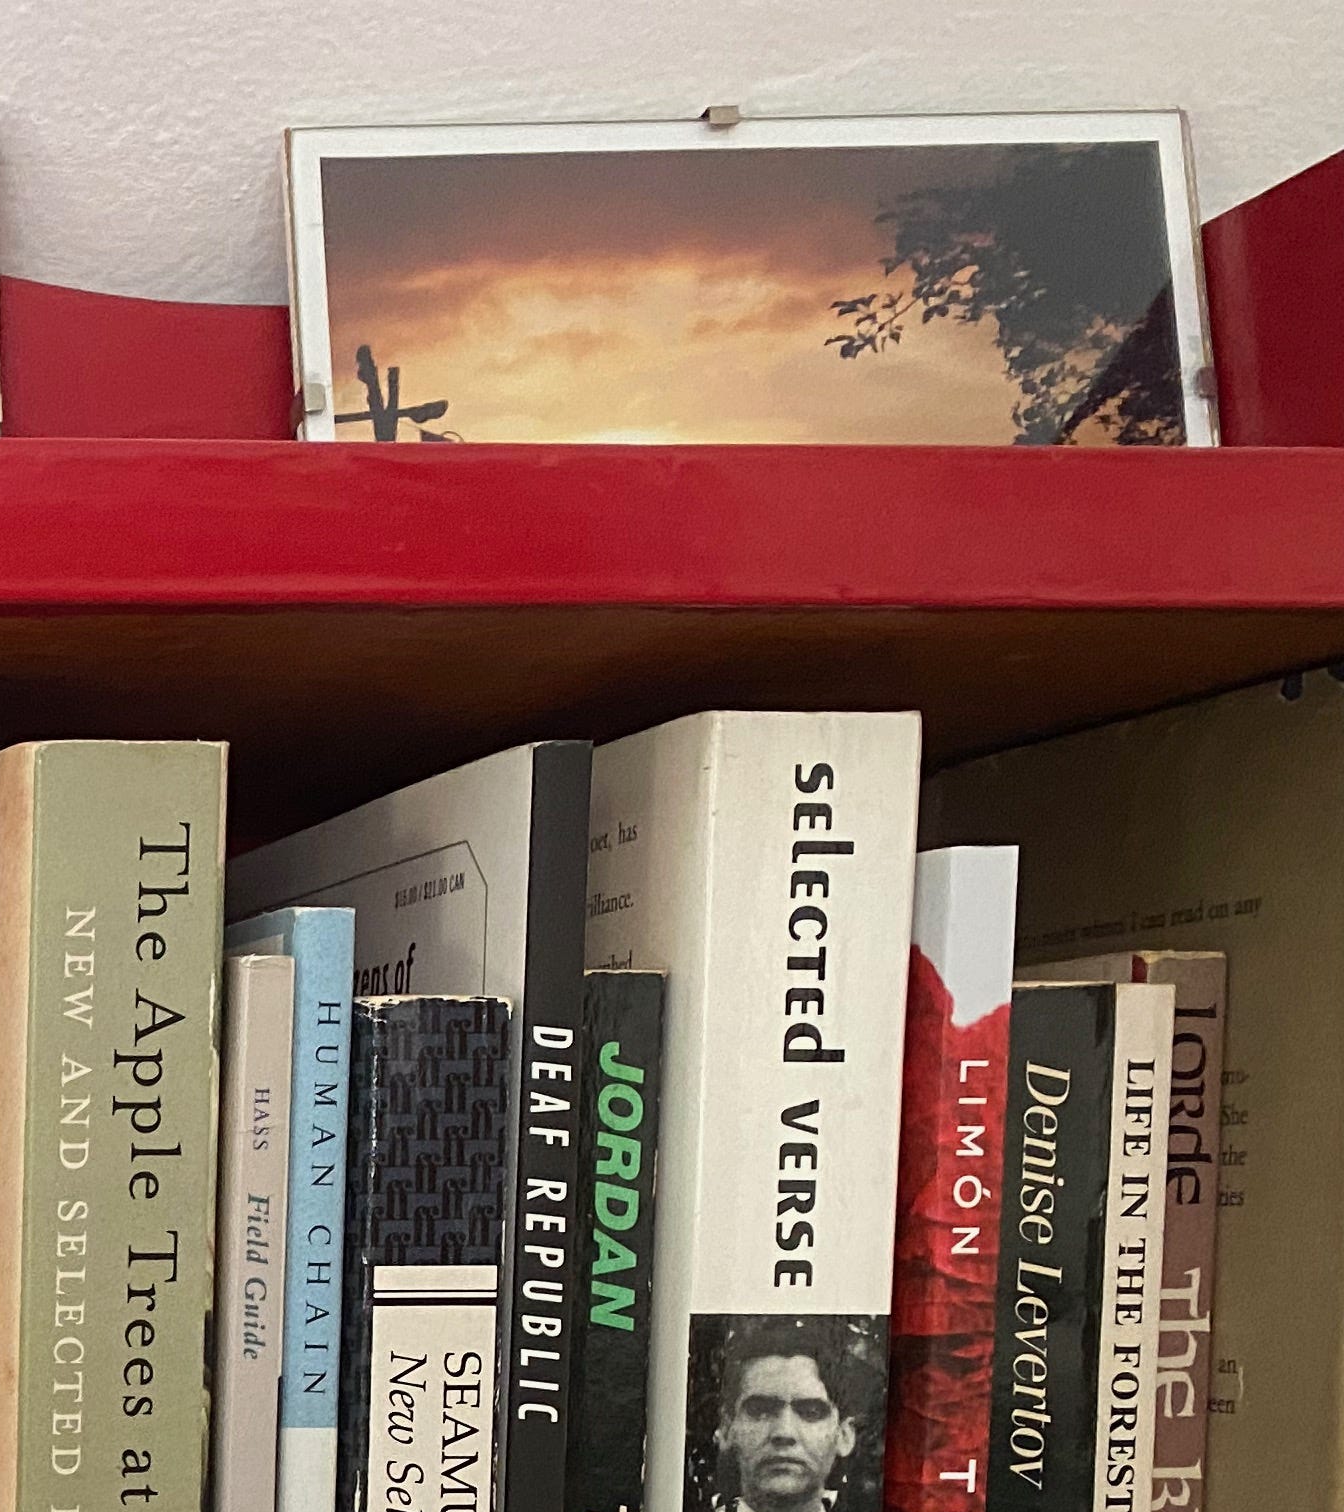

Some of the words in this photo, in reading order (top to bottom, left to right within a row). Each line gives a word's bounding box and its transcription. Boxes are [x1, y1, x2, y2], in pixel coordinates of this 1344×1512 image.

[64, 907, 96, 1026] NEW
[135, 821, 190, 962] The
[114, 989, 186, 1202] Apple
[310, 1001, 340, 1191] HUMAN
[530, 1024, 573, 1147] DEAF
[950, 1059, 989, 1256] LIMÓN
[1014, 1059, 1070, 1241] Denise
[1122, 1058, 1155, 1157] LIFE
[246, 1192, 272, 1266] Field
[589, 1041, 644, 1331] JORDAN
[1121, 1173, 1150, 1218] IN
[53, 1200, 89, 1477] SELECTED
[120, 1231, 177, 1417] Trees
[242, 1277, 267, 1362] Guide
[302, 1225, 332, 1397] CHAIN
[519, 1178, 566, 1421] REPUBLIC
[1115, 1234, 1149, 1326] THE
[1007, 1255, 1064, 1489] Levertov
[121, 1445, 160, 1505] at
